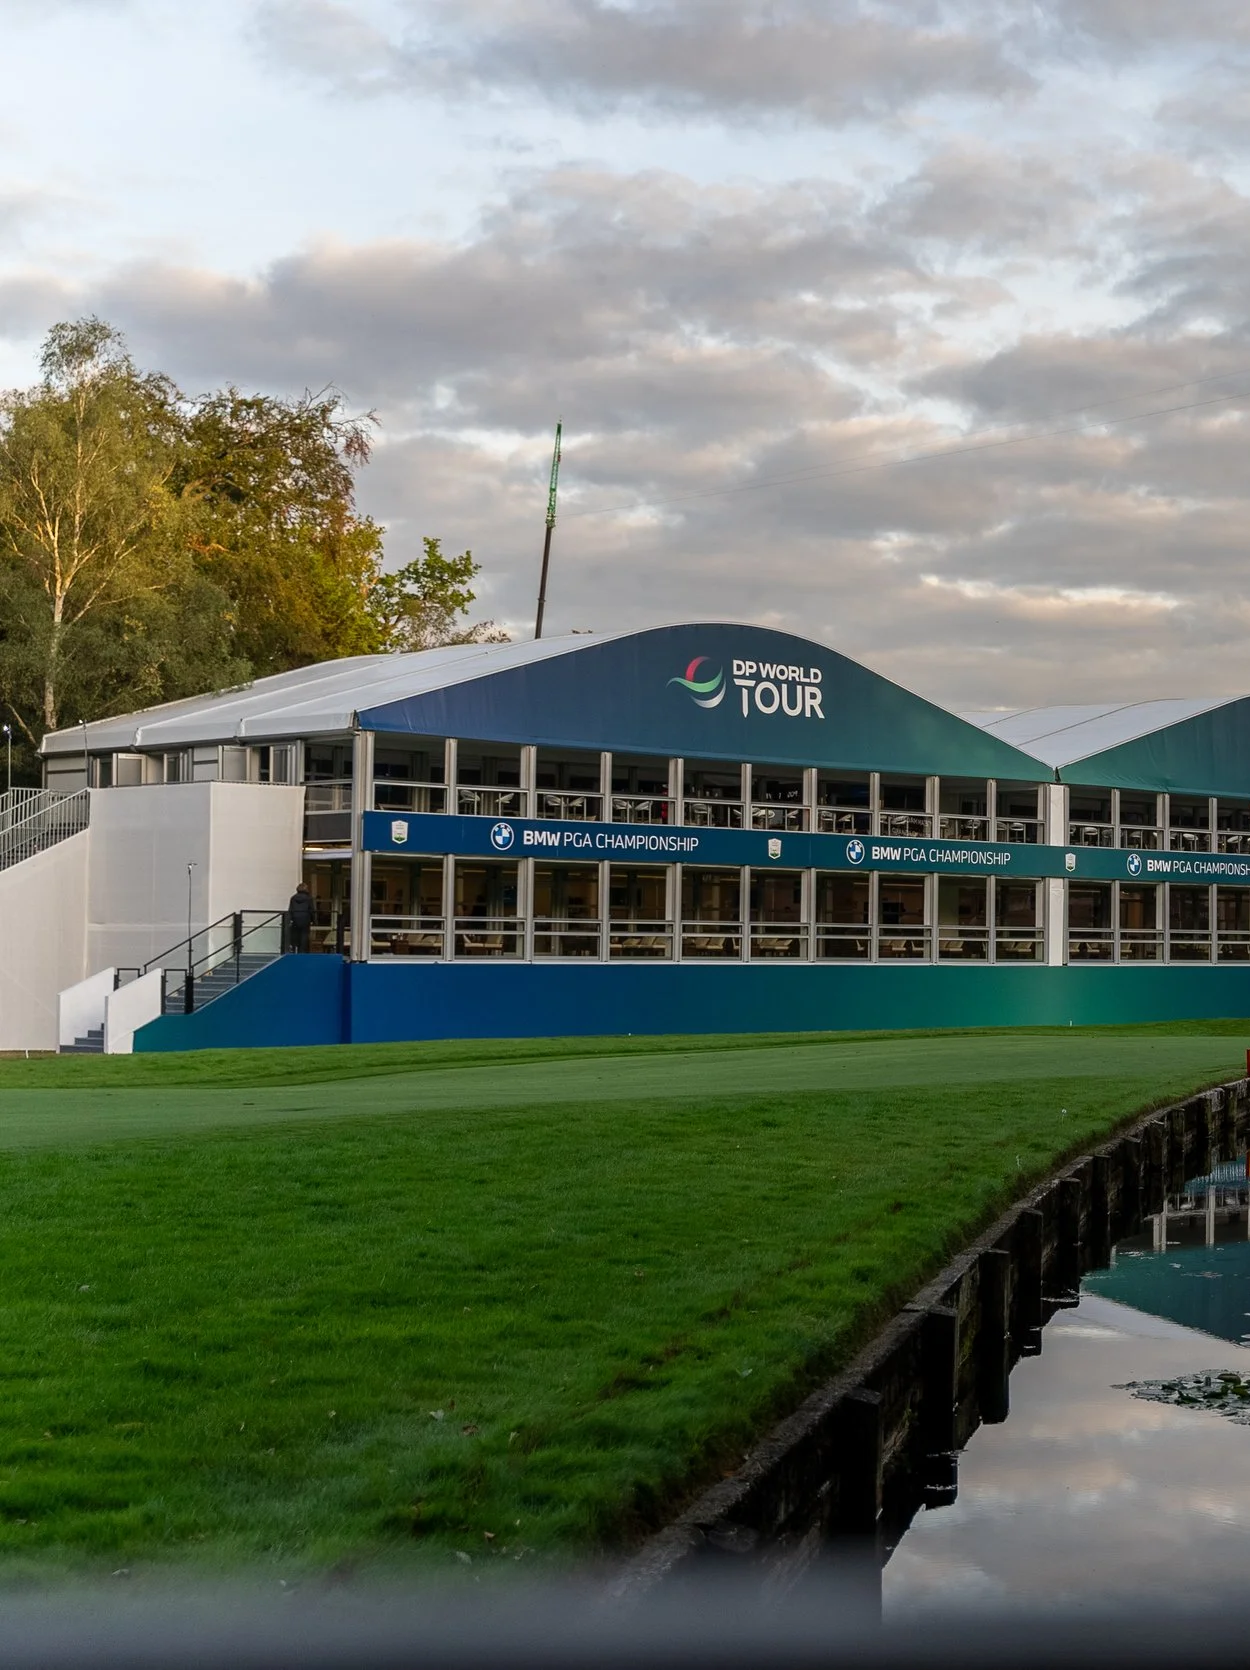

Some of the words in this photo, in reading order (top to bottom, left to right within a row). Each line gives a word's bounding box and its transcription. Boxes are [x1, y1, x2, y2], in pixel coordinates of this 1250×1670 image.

[733, 660, 757, 677] DP
[759, 662, 822, 684] WORLD
[733, 678, 825, 719] TOUR
[523, 830, 561, 846] BMW
[563, 832, 592, 847] PGA
[595, 833, 699, 851] CHAMPIONSHIP
[872, 846, 901, 860] BMW
[903, 848, 927, 862] PGA
[929, 848, 1011, 865] CHAMPIONSHIP
[1147, 859, 1172, 872] BMW
[1173, 860, 1192, 873] PGA
